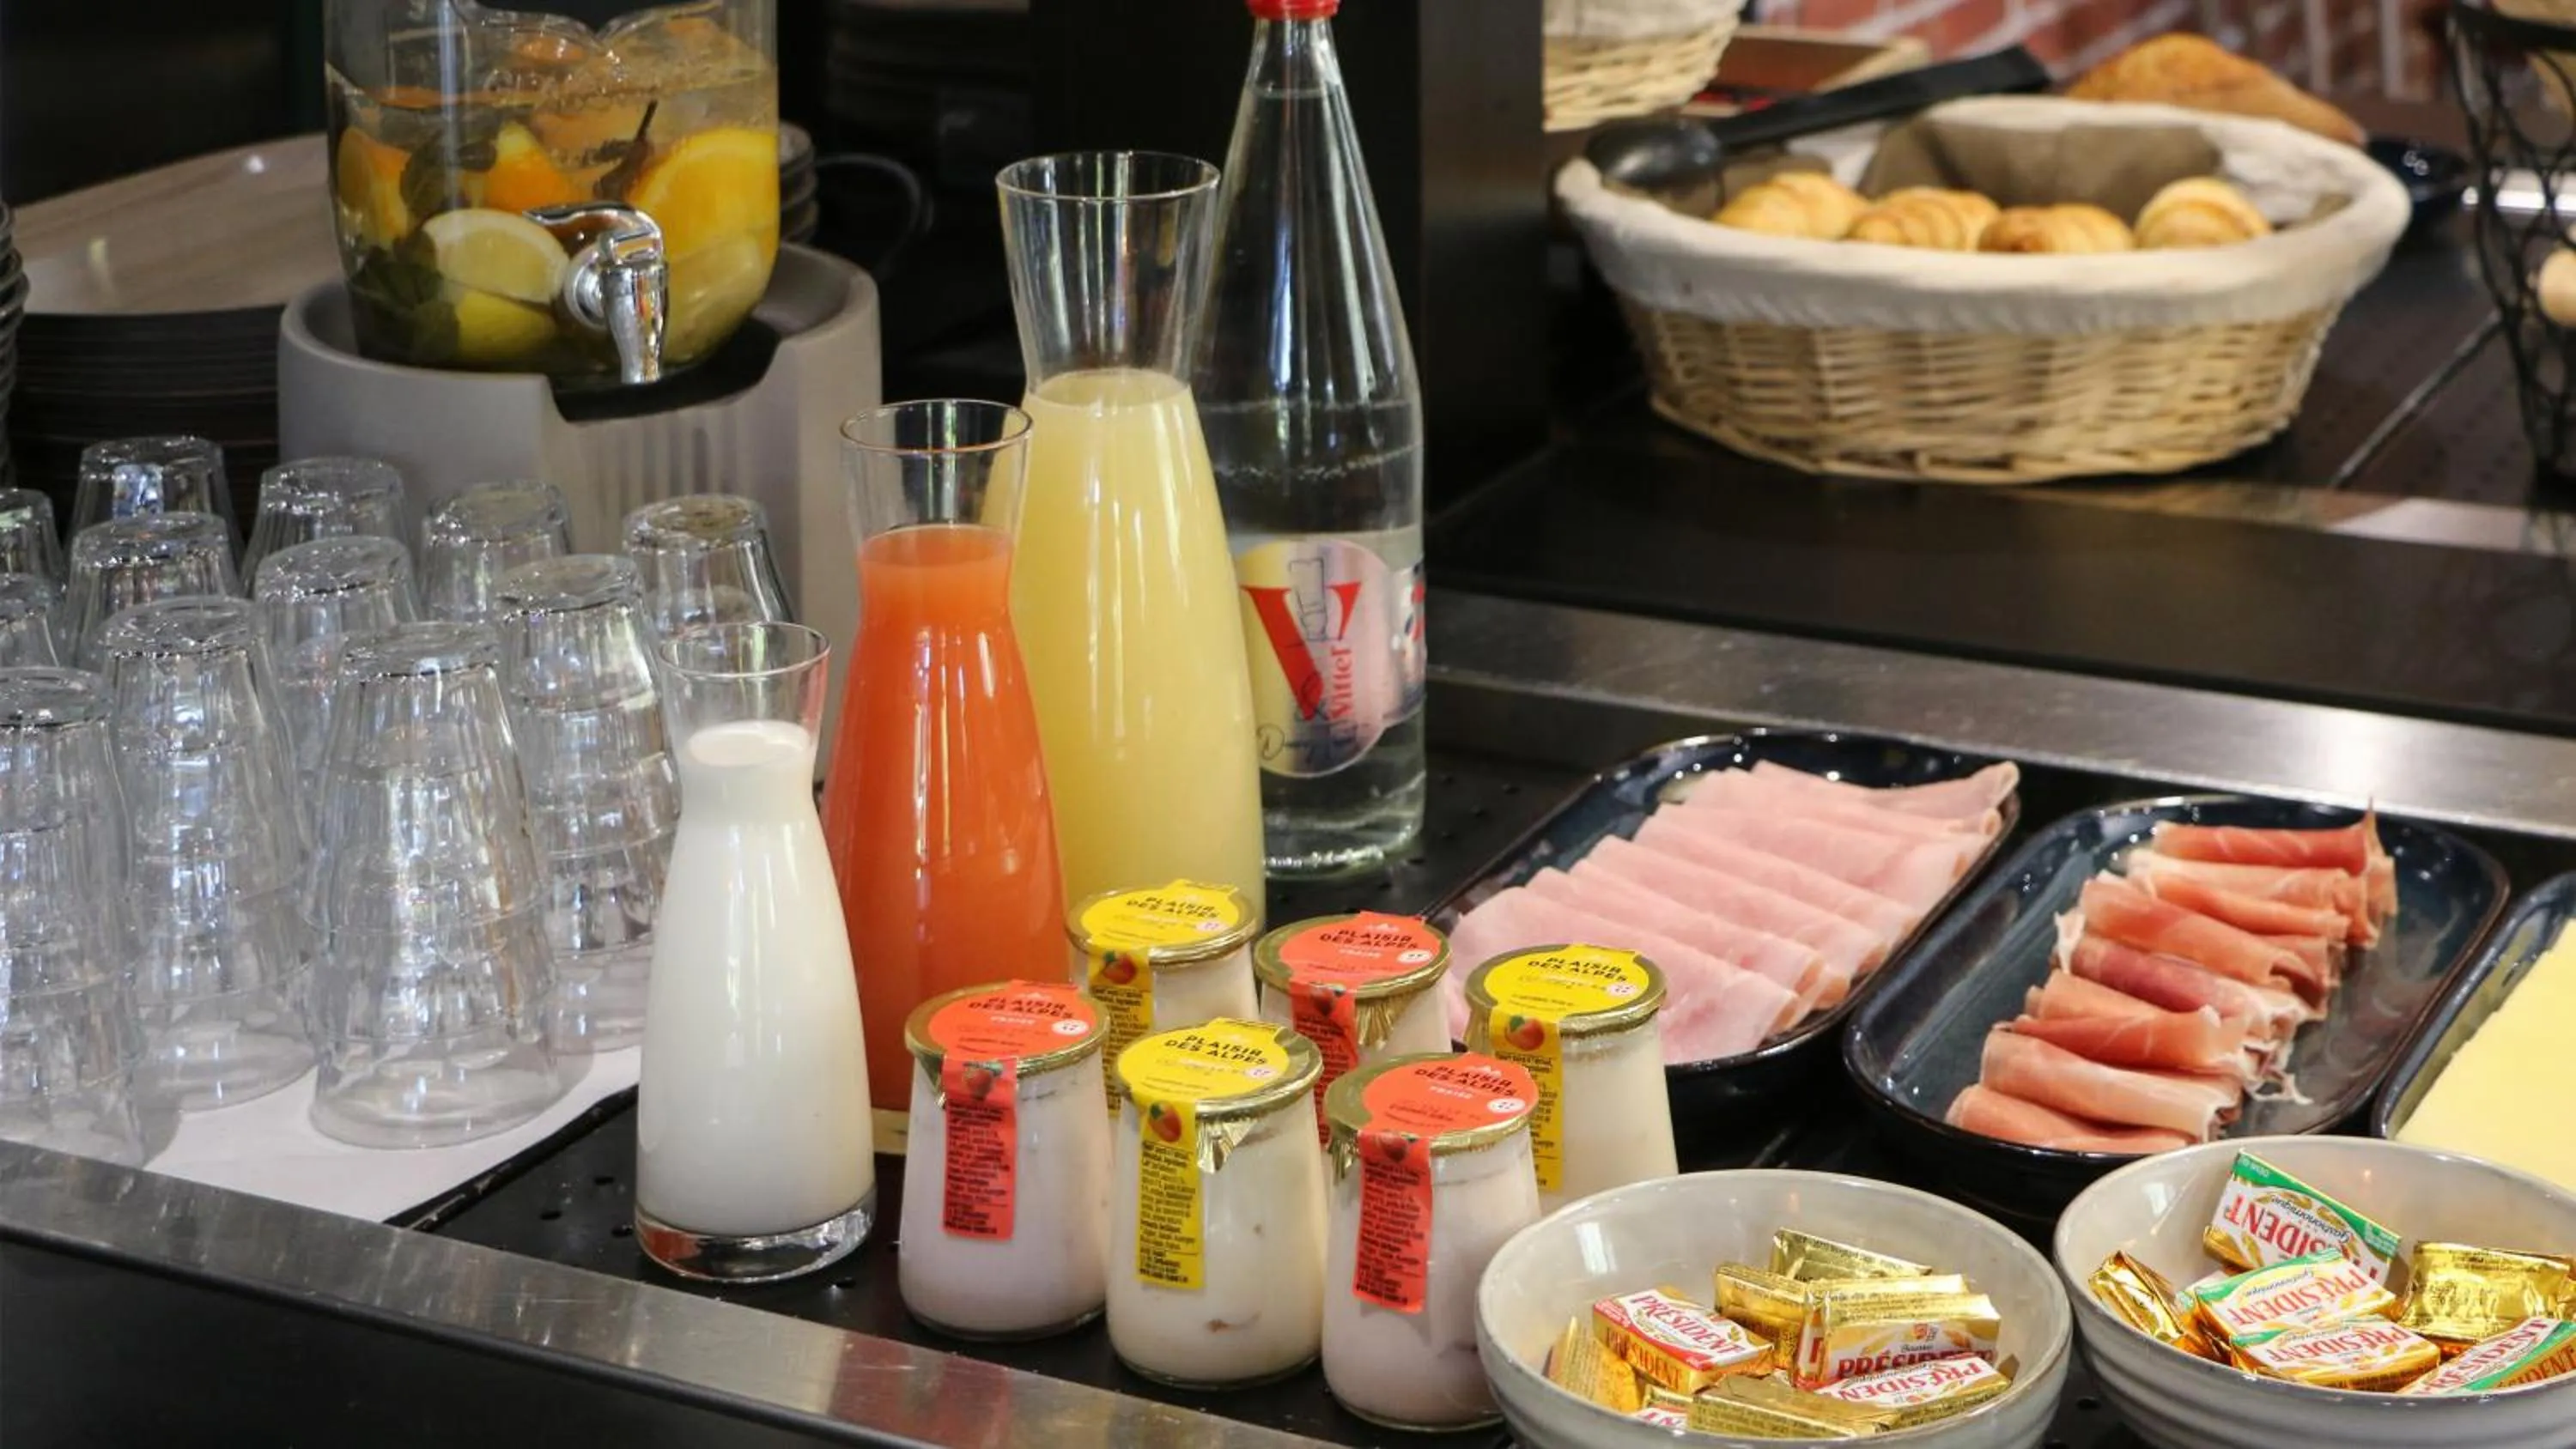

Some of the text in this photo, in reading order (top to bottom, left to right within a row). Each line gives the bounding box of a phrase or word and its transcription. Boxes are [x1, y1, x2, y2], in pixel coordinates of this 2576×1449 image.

[1239, 581, 1362, 721] V
[1126, 899, 1220, 919] DES ALPES
[1145, 896, 1215, 912] PLAISIR
[1320, 932, 1419, 949] DES ALPES
[1338, 930, 1413, 943] PLAISIR
[1528, 960, 1628, 982] DES ALPES
[1546, 956, 1622, 973] PLAISIR
[968, 1001, 1074, 1019] DES ALPES
[988, 997, 1066, 1010] PLAISIR
[1163, 1039, 1268, 1065] DES ALPES
[1185, 1034, 1263, 1057] PLAISIR
[1414, 1068, 1517, 1096] DES ALPES
[1435, 1065, 1512, 1088] PLAISIR
[1839, 1362, 1983, 1402] PRÉSIDEN
